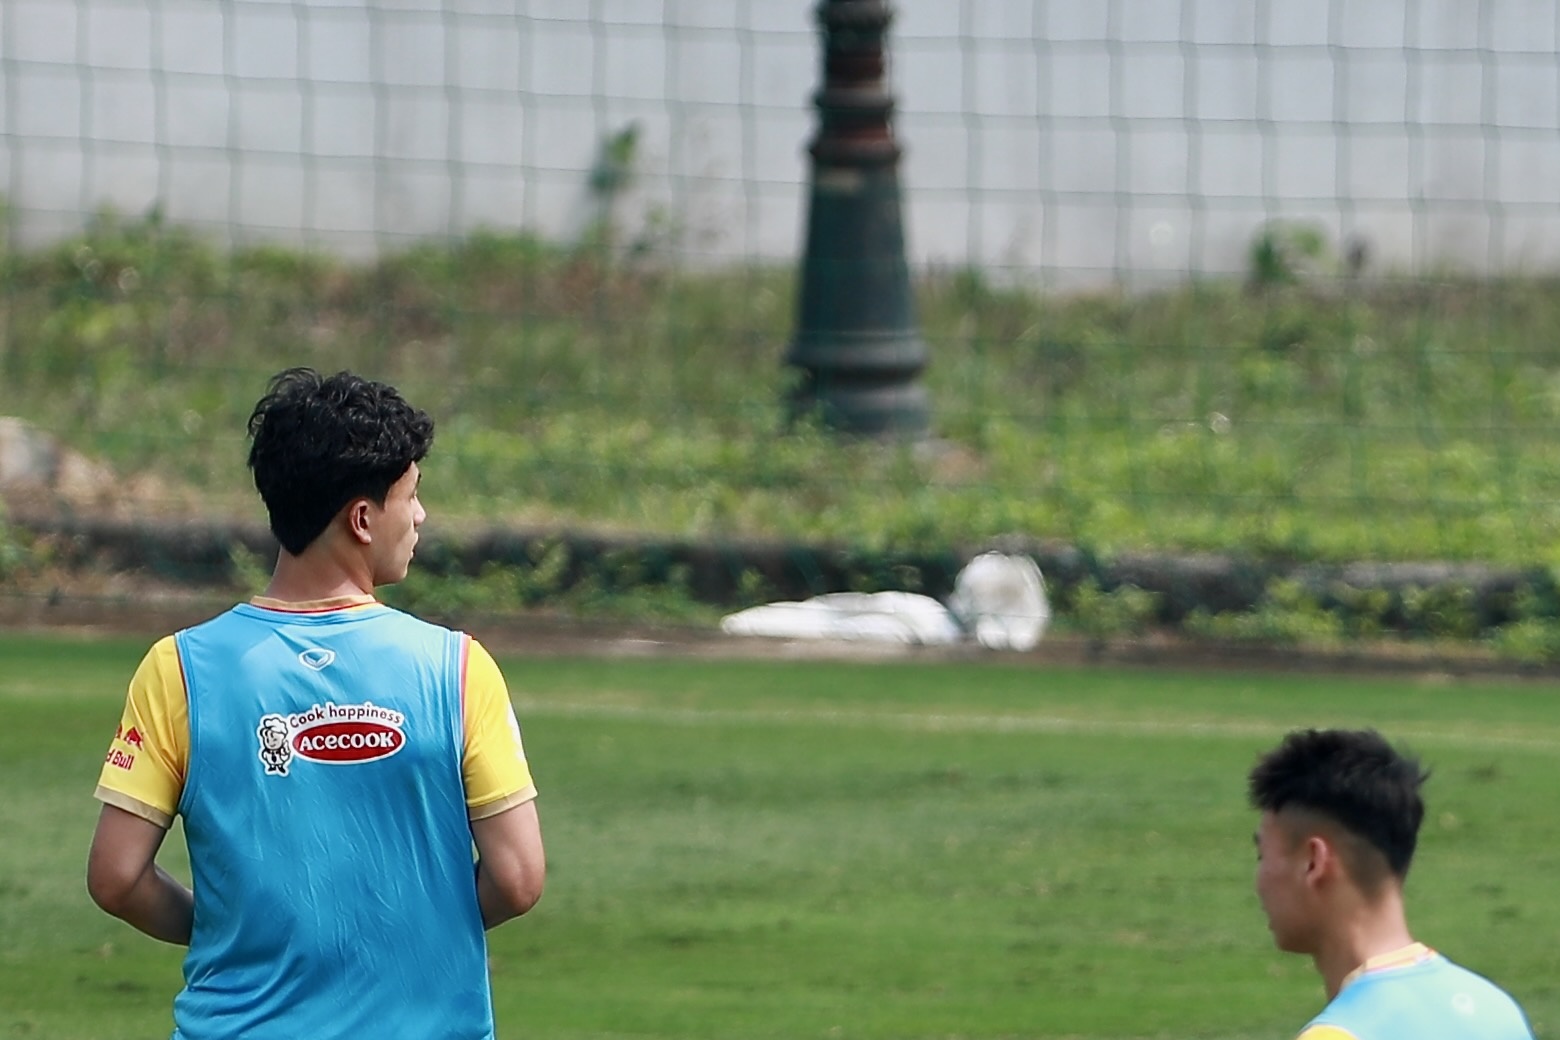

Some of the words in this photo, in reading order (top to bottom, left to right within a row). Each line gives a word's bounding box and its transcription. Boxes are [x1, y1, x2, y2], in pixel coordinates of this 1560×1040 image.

[290, 707, 324, 728] Cook
[329, 704, 401, 724] happiness
[112, 750, 135, 770] Bull
